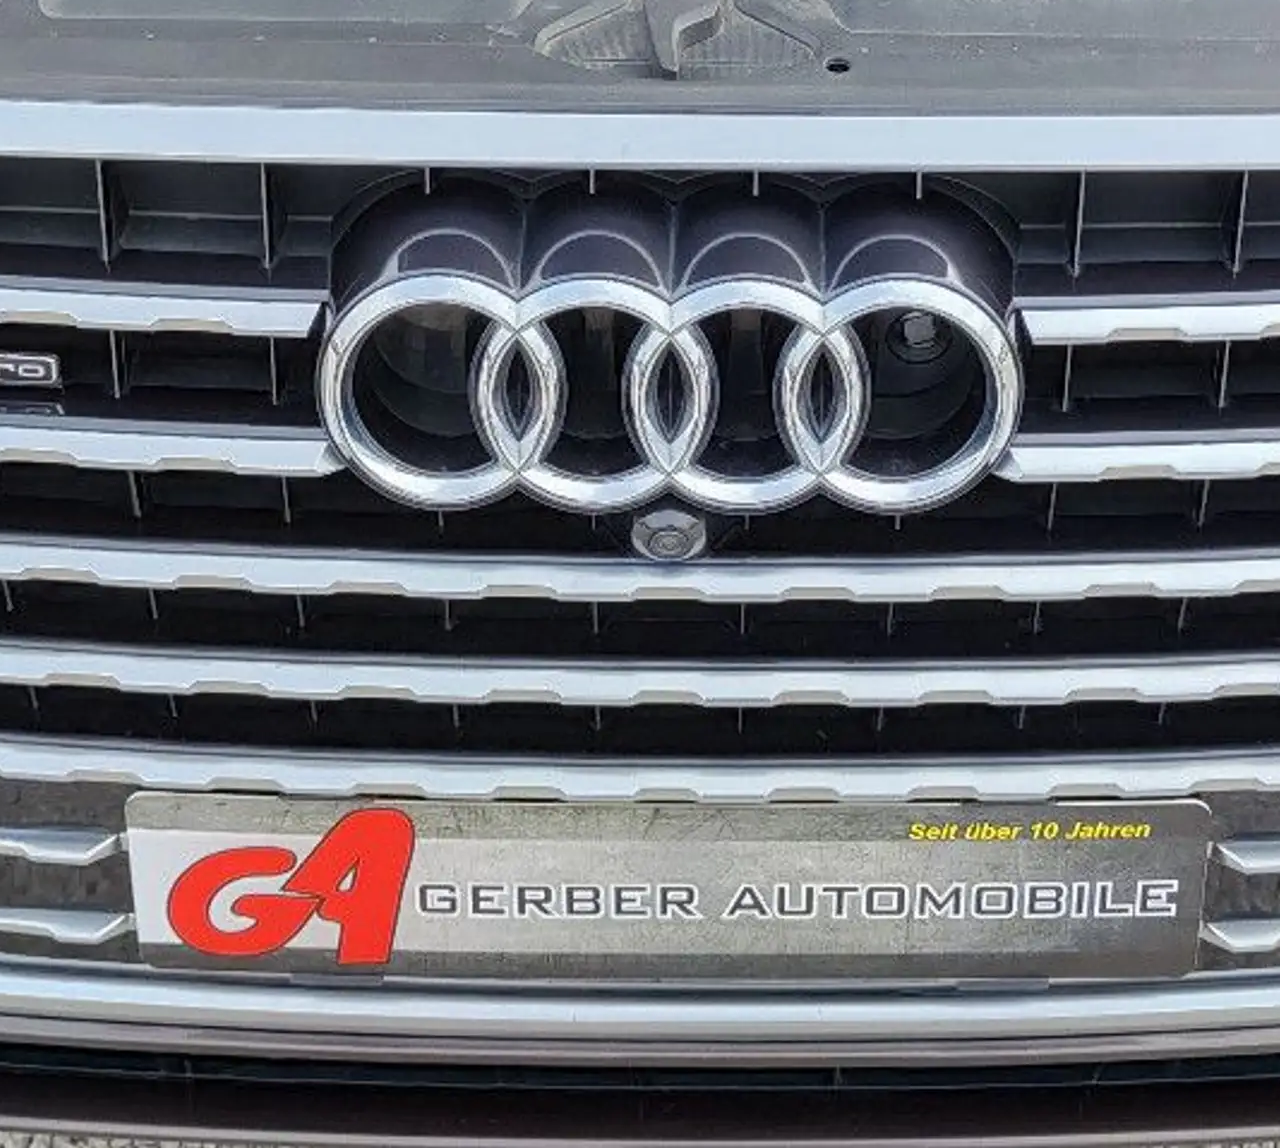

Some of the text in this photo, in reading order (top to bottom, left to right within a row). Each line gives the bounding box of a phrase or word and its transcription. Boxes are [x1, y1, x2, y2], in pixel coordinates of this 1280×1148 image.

[908, 821, 1151, 841] Seit über 10 Jahren
[167, 807, 416, 965] GA
[416, 880, 1179, 919] GERBER AUTOMOBILE
